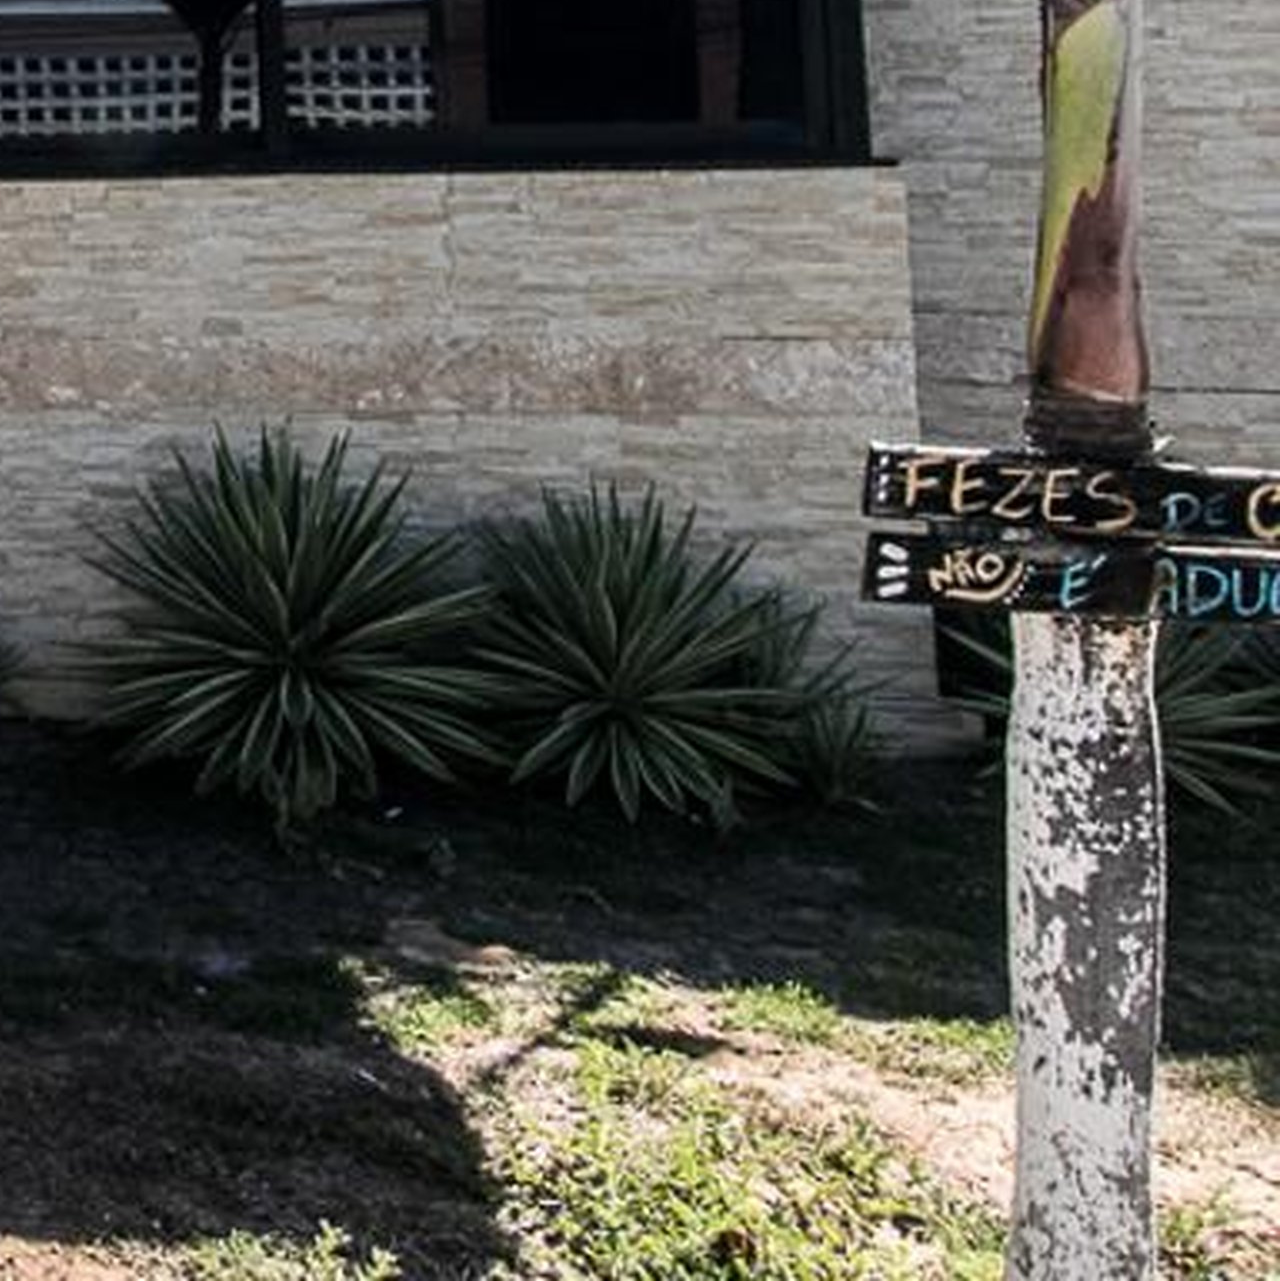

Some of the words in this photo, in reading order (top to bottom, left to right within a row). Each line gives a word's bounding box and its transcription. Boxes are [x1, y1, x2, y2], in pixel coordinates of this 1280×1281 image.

[897, 455, 1138, 531] FEZES
[1159, 491, 1229, 532] DE
[927, 548, 1005, 592] NÃO
